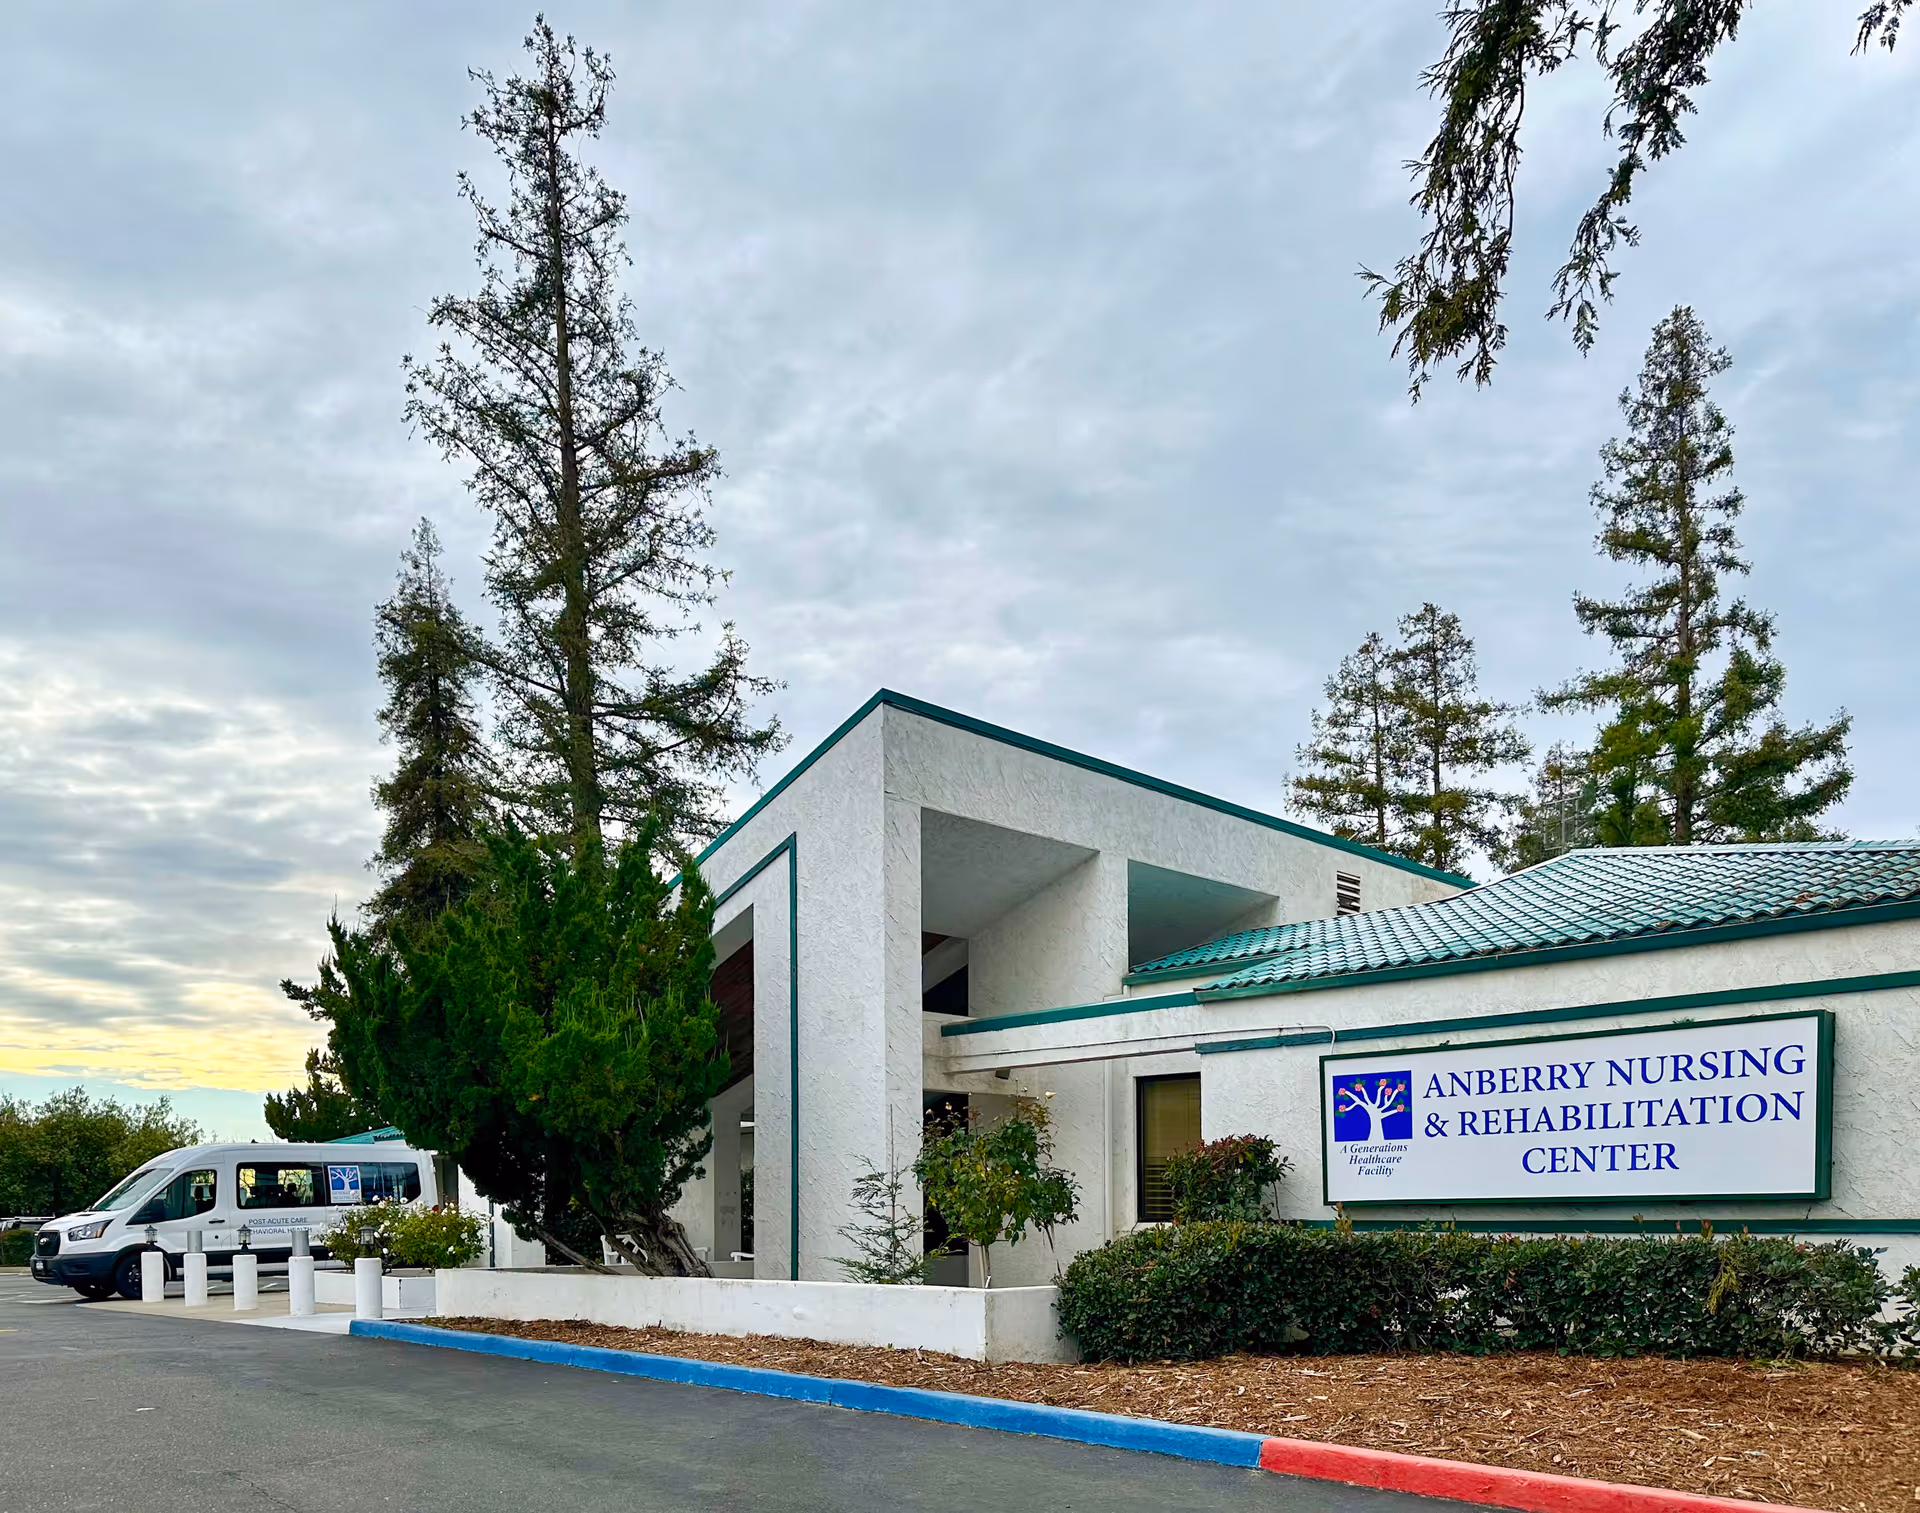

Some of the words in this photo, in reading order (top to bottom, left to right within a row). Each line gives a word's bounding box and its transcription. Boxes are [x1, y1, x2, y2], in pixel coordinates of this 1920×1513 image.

[1423, 1061, 1596, 1099] ANBERRY
[1606, 1044, 1806, 1087] NURSING
[1424, 1113, 1448, 1138] &
[1458, 1091, 1804, 1136] REHABILITATION
[1340, 1144, 1347, 1153] A
[1350, 1143, 1408, 1153] Generations
[1349, 1154, 1402, 1164] Healthcare
[1522, 1143, 1680, 1175] CENTER
[1358, 1165, 1394, 1177] Facility
